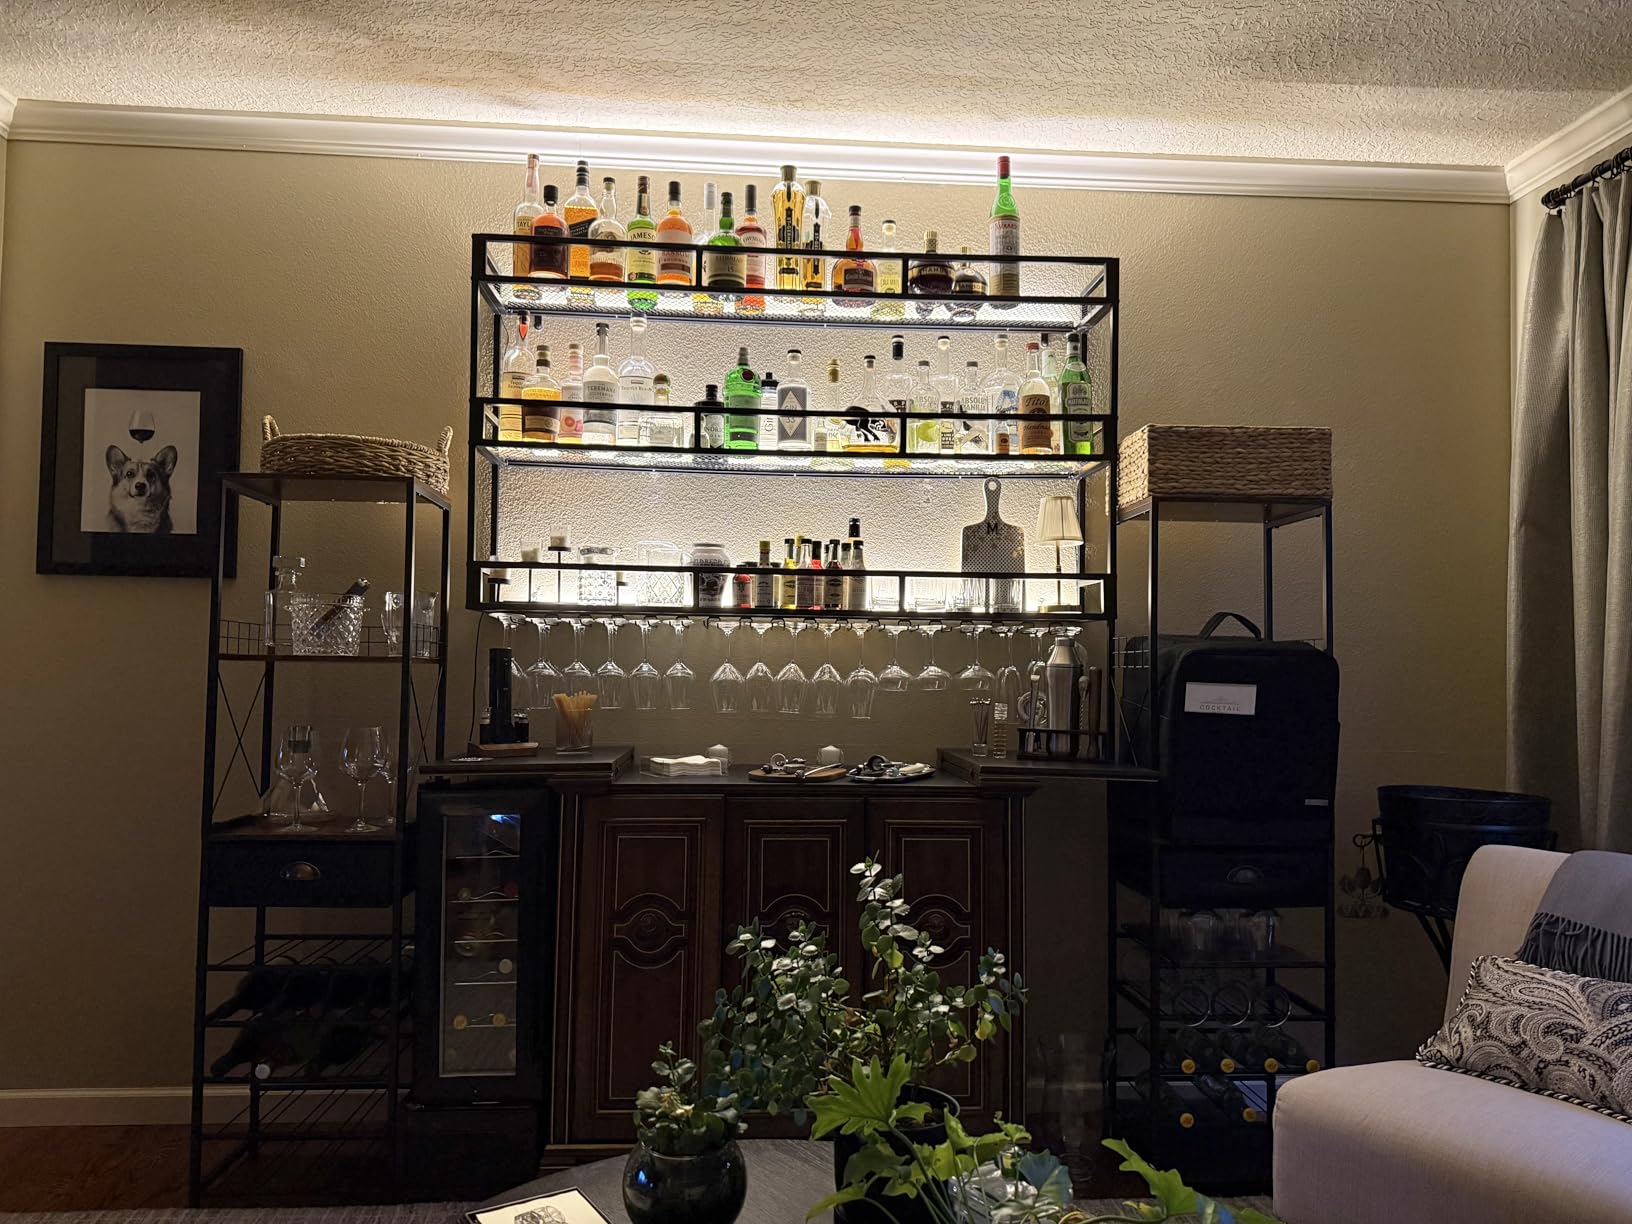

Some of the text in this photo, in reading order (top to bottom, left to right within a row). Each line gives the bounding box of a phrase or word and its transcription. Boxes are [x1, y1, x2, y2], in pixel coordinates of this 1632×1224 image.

[630, 231, 656, 241] JAMESO
[987, 522, 998, 535] M
[1199, 704, 1241, 712] COCKTAIL
